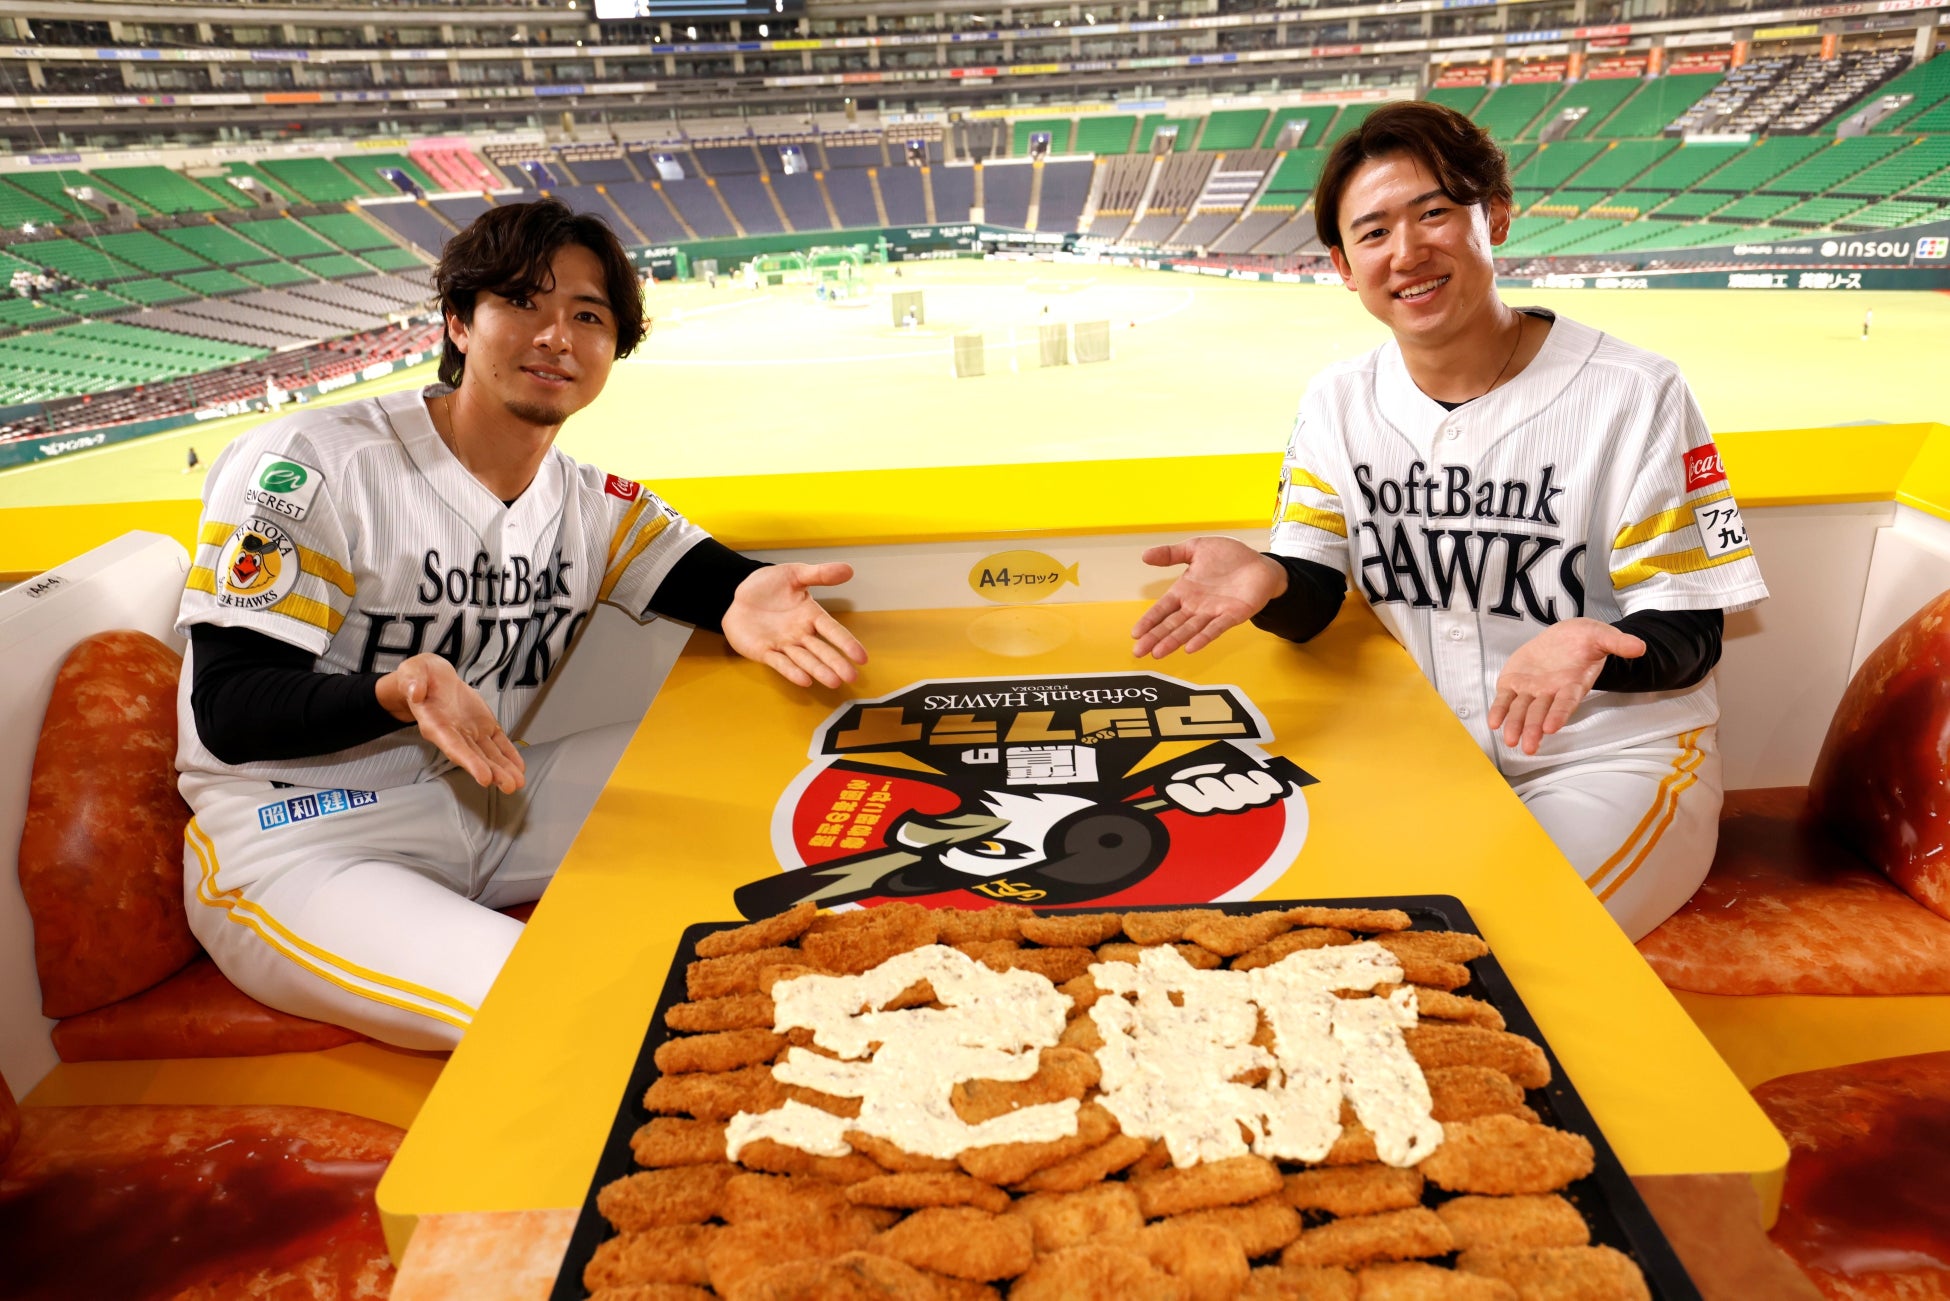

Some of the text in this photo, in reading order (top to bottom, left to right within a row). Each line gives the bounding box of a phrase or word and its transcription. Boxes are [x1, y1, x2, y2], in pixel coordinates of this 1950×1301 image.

[1354, 460, 1565, 527] SoftBank
[1702, 508, 1739, 530] ファ
[235, 589, 279, 608] HAWKS
[923, 686, 1158, 711] SoftBank HAWKS
[1011, 683, 1069, 692] FUKUOKA
[261, 789, 376, 828] 昭和建設
